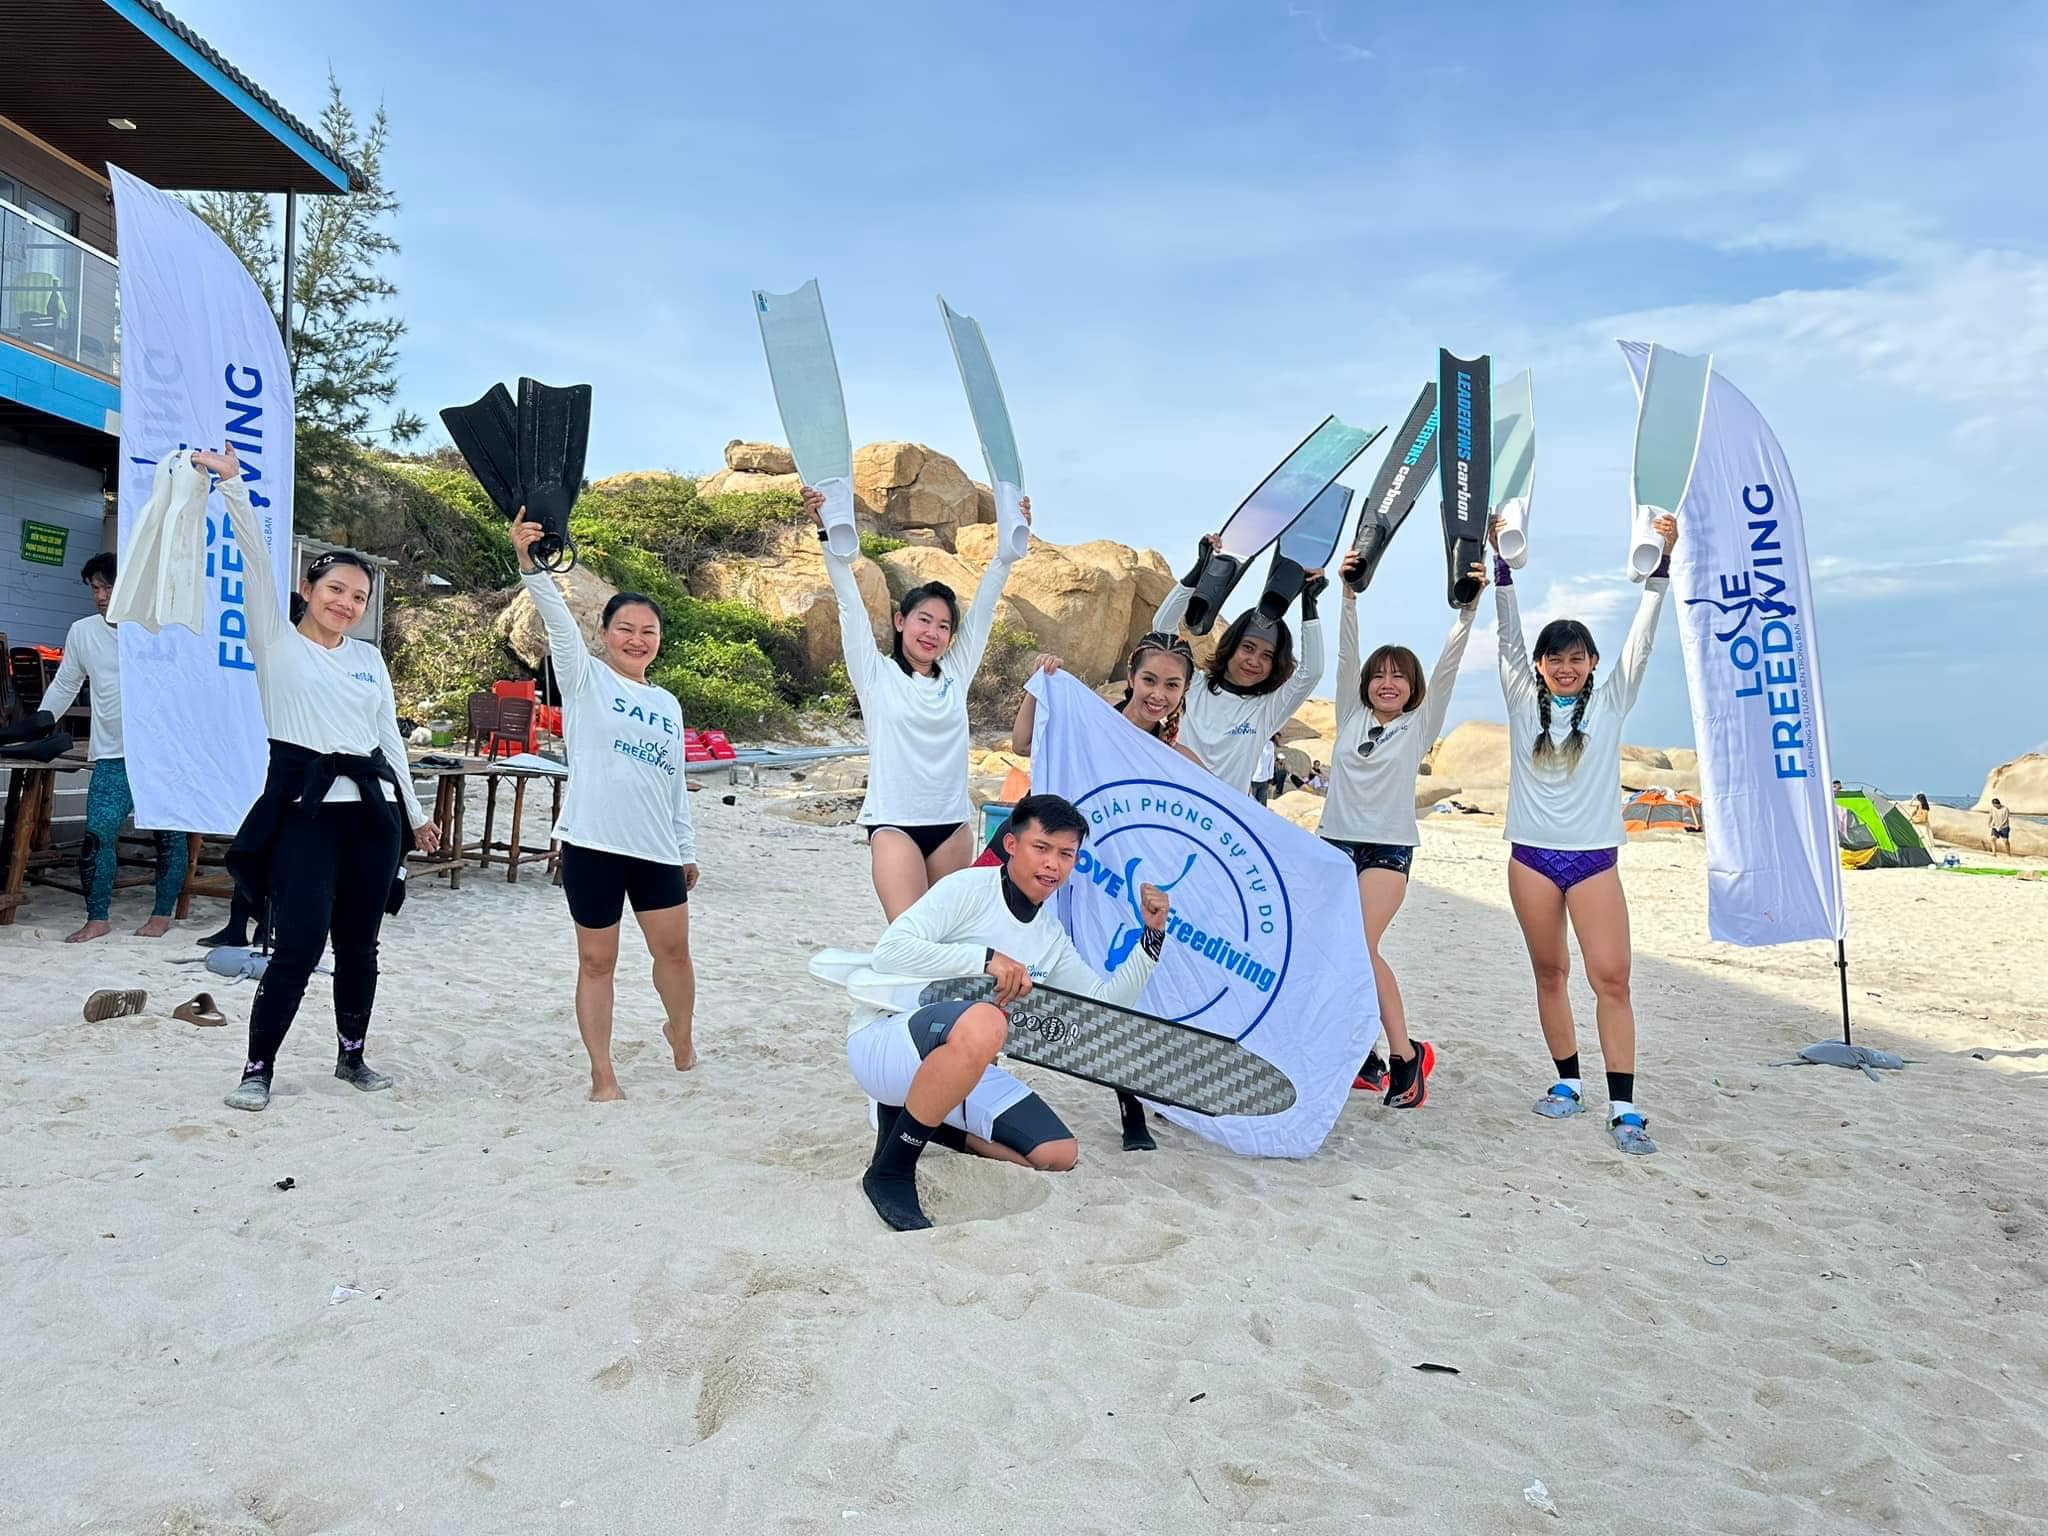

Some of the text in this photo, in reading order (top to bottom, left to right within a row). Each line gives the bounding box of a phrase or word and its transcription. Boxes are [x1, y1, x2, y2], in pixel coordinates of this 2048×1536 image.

[1457, 371, 1472, 521] LEADERFINS carbon
[1378, 466, 1410, 514] carbon
[612, 697, 674, 735] SAFE
[1075, 849, 1125, 899] OVE
[1141, 797, 1214, 832] PHÓNG
[1219, 831, 1248, 858] SỰ
[1245, 864, 1268, 893] TỰ
[1258, 904, 1274, 935] DO
